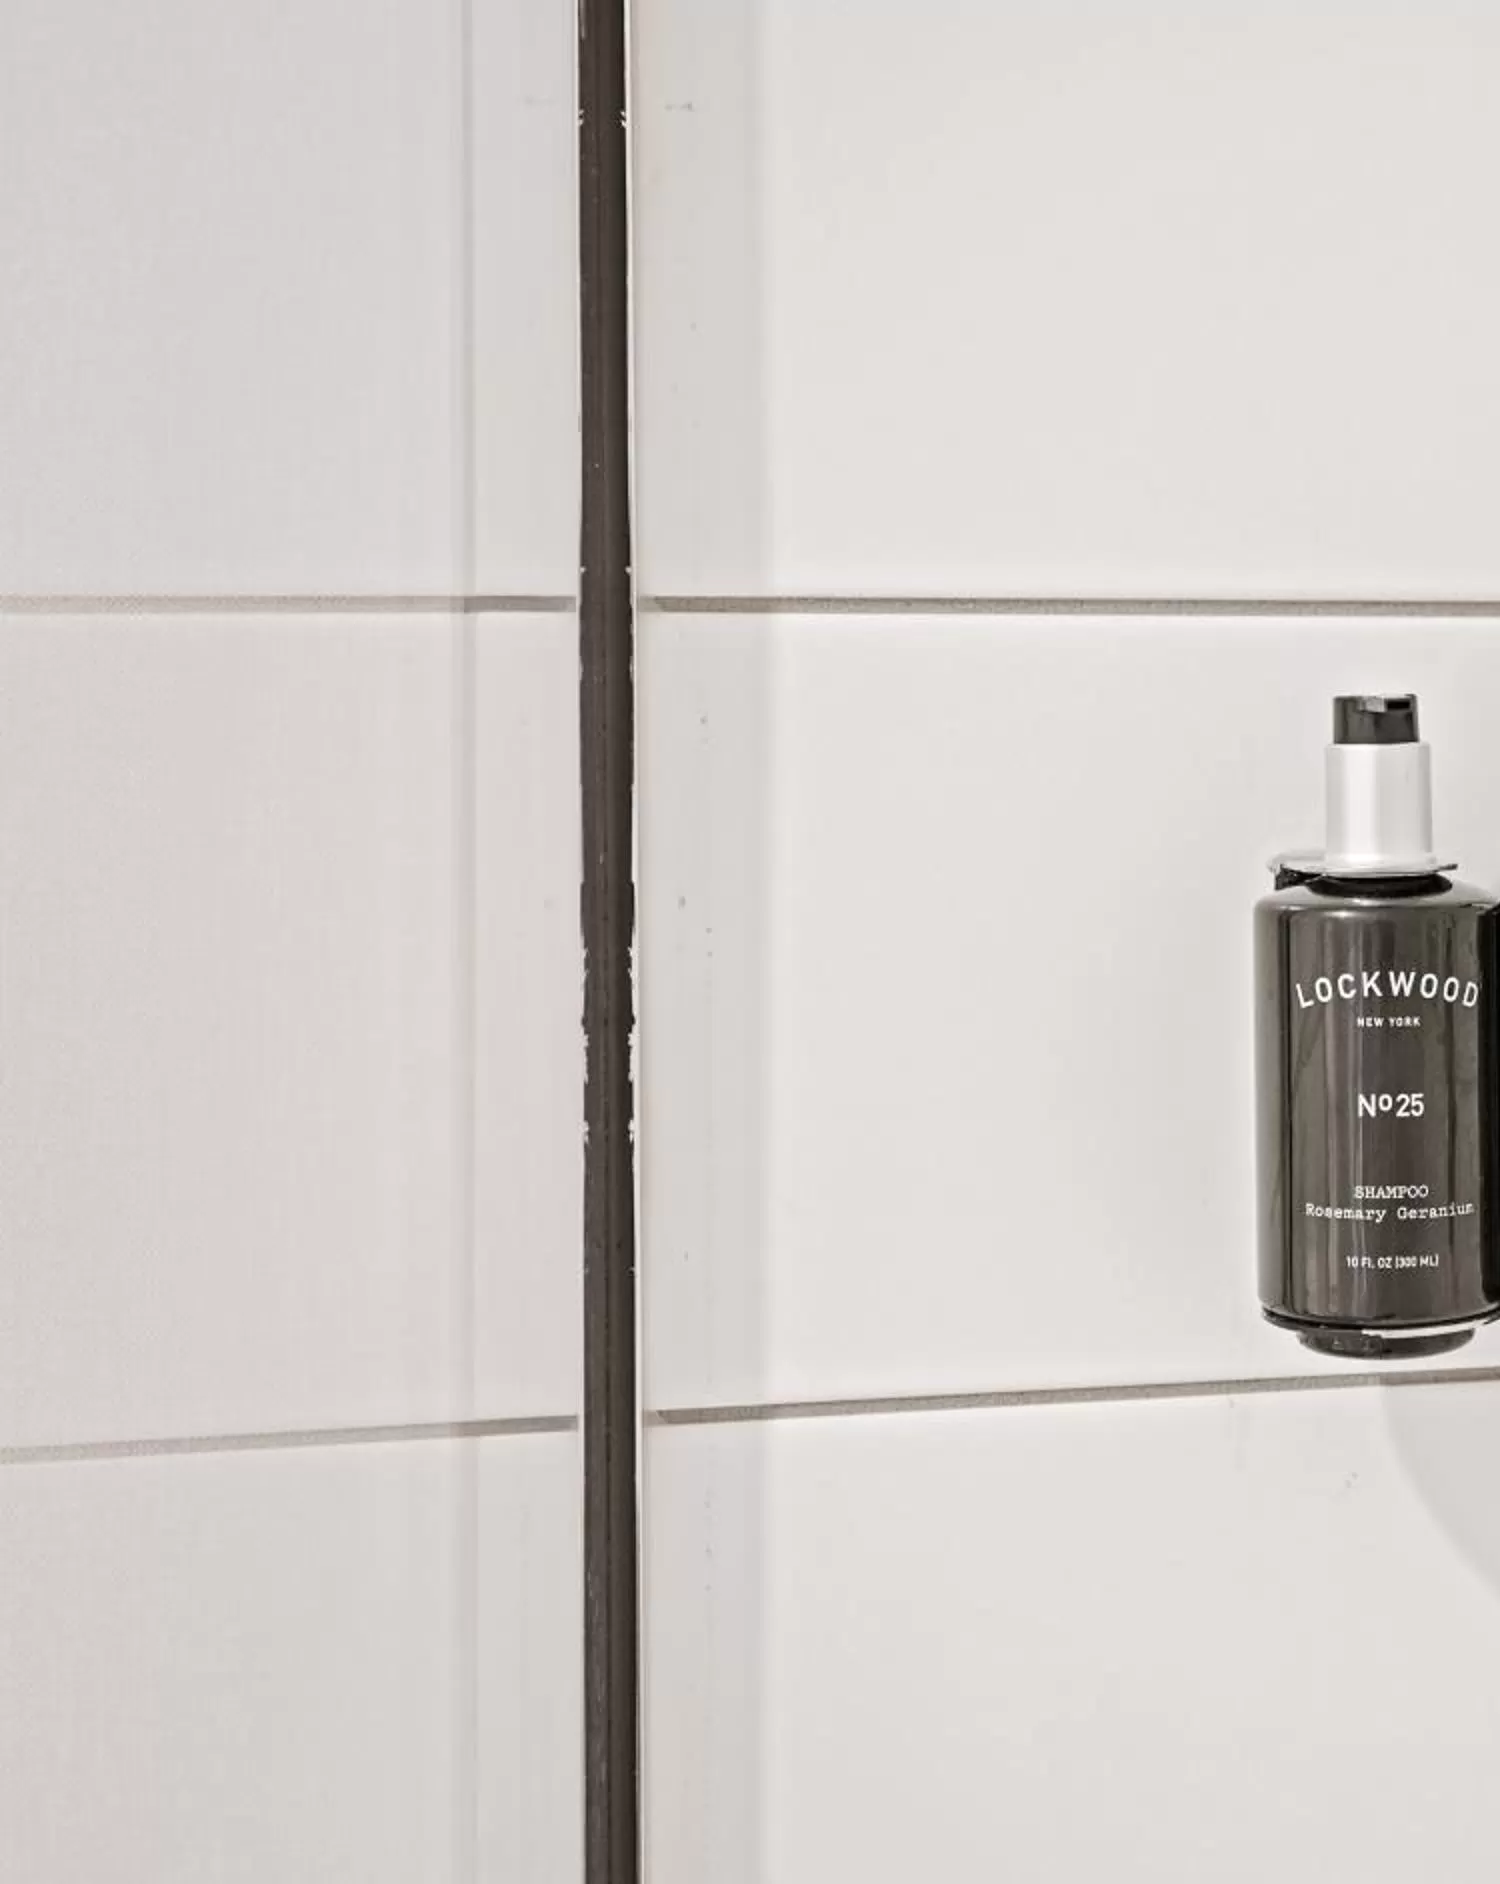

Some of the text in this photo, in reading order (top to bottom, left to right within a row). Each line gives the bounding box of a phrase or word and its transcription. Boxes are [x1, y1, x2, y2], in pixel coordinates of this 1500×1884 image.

[1296, 971, 1479, 1009] LOCKWOOD
[1357, 1016, 1421, 1027] NEW YORK
[1354, 1185, 1429, 1200] SHAMPOO
[1305, 1202, 1474, 1223] Rosemary Geranium
[1346, 1255, 1359, 1268] 10
[1377, 1255, 1393, 1268] OZ
